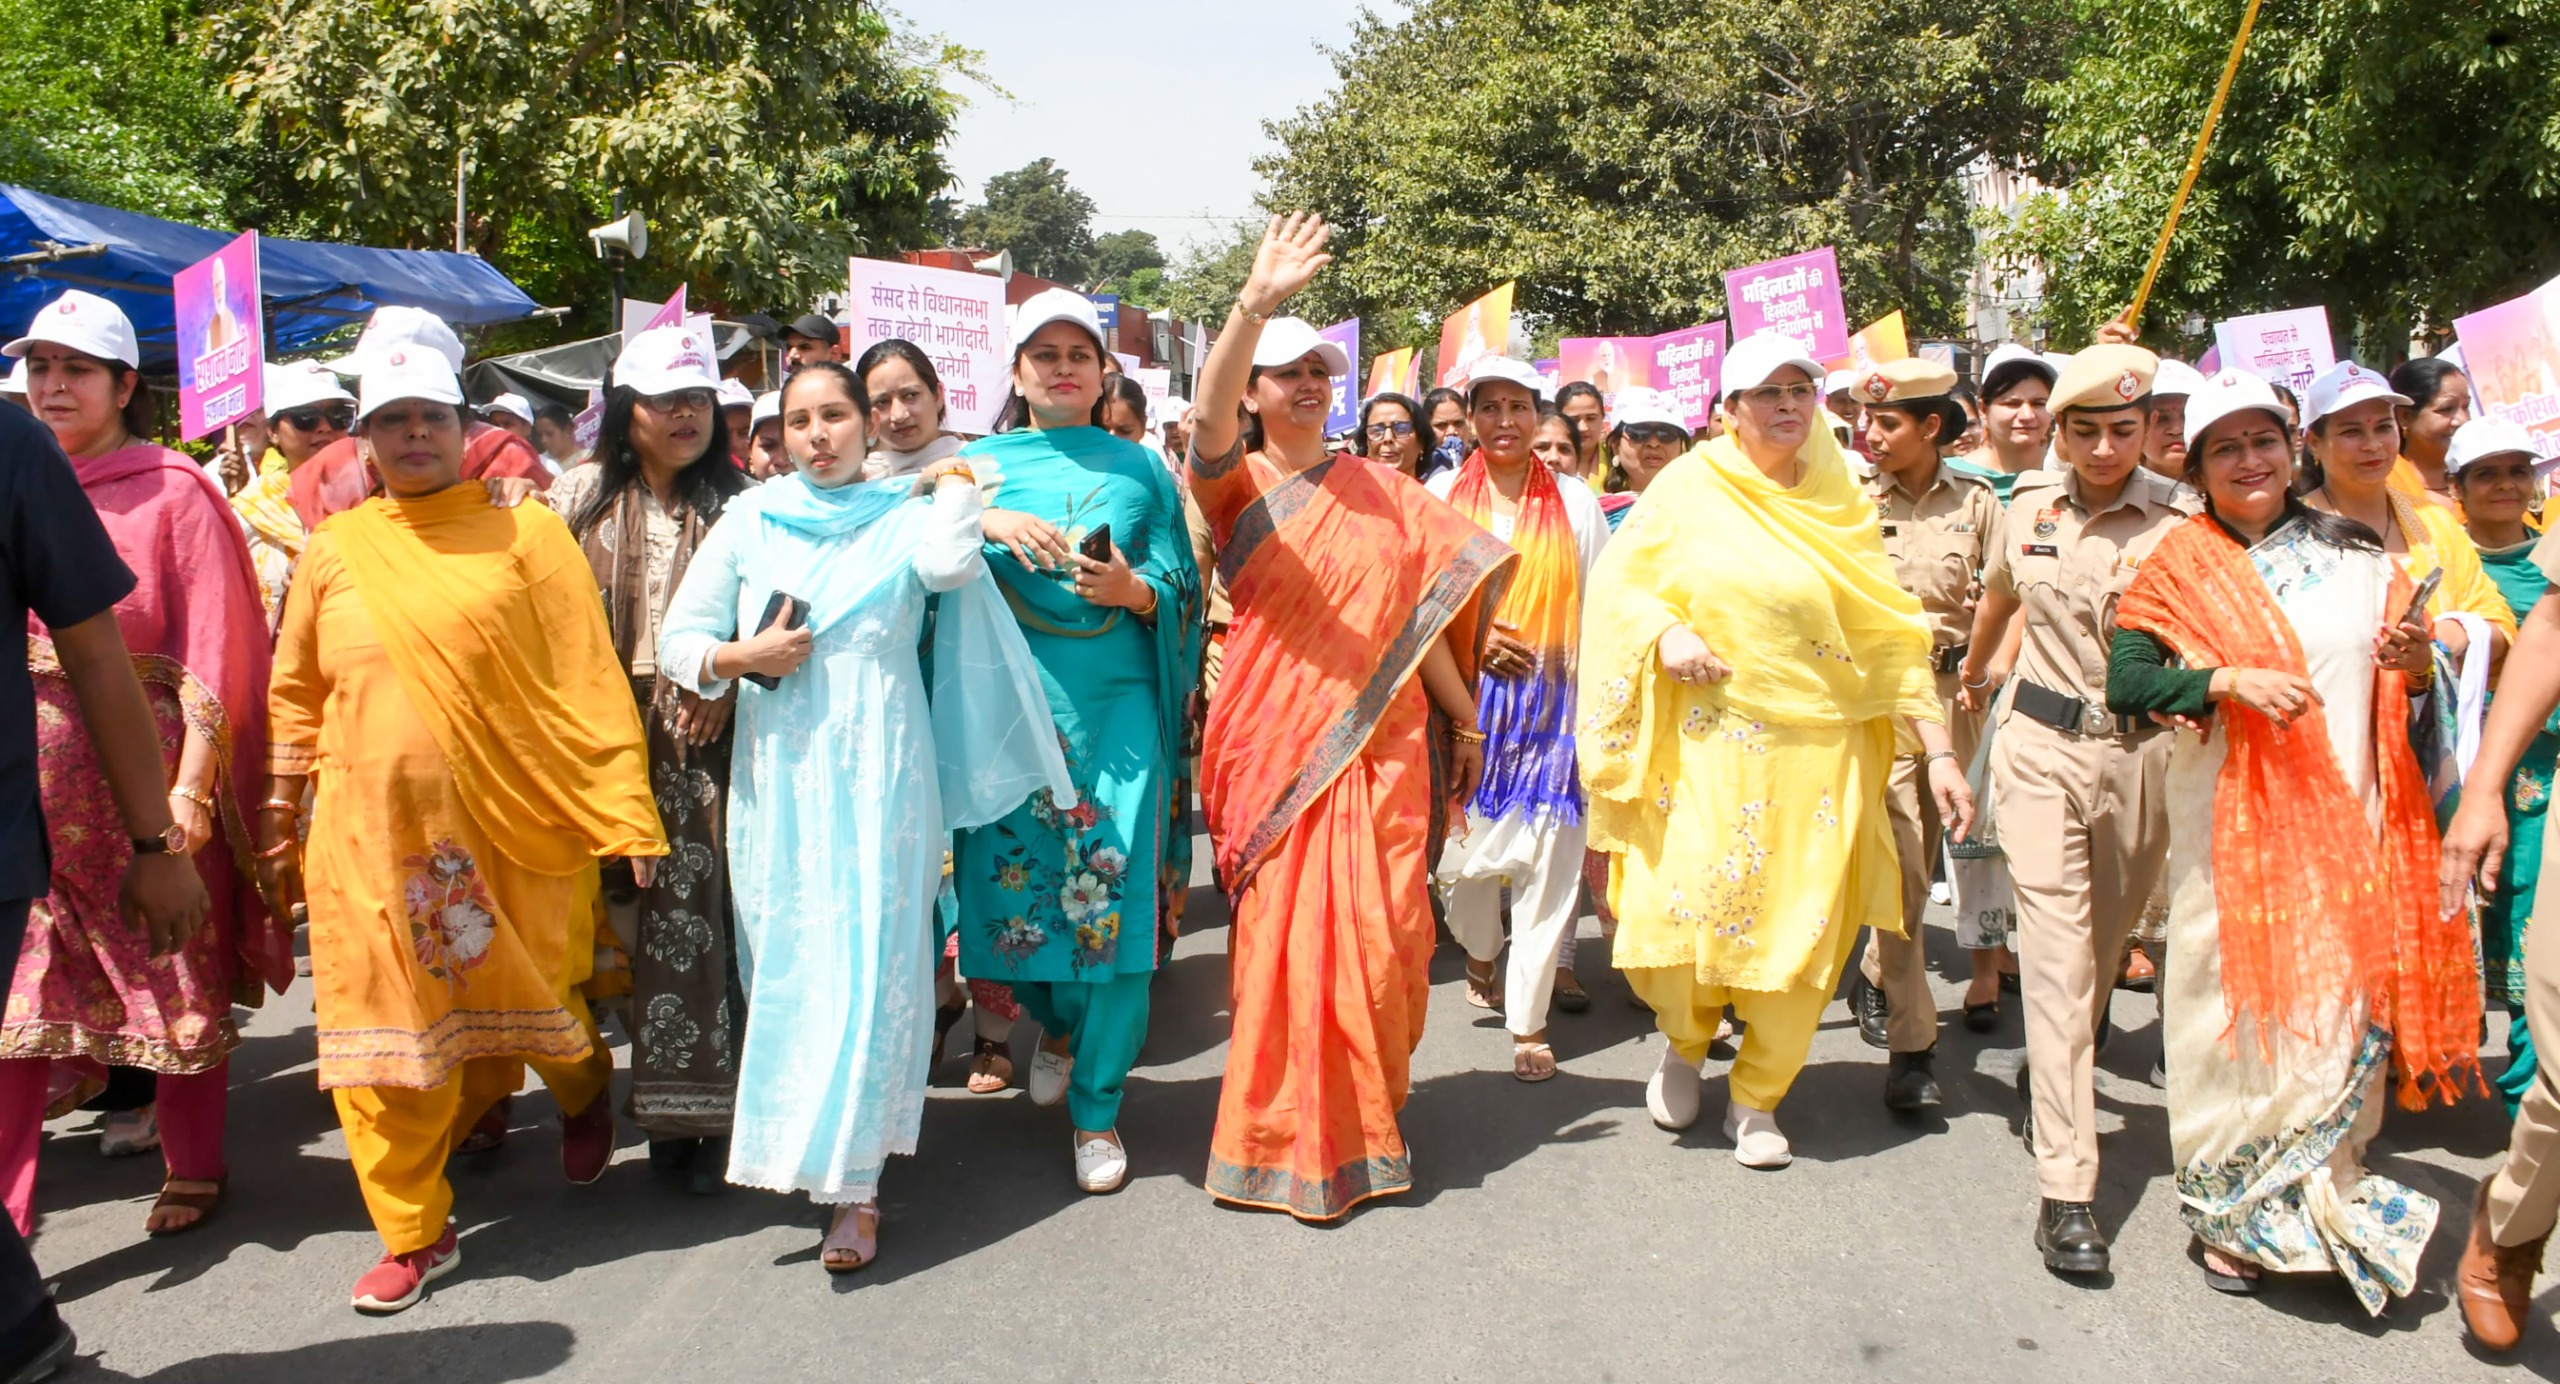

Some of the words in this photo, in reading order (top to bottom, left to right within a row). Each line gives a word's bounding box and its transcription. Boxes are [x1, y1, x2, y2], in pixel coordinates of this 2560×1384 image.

[1741, 266, 1807, 303] महिलाओं
[1807, 268, 1823, 288] की
[871, 282, 904, 311] संसद
[907, 284, 919, 311] से
[923, 286, 989, 320] विधानसभा
[868, 317, 892, 340] तक
[935, 321, 992, 354] भागीदारी,
[2260, 328, 2288, 346] पंचायत
[2289, 324, 2298, 342] से
[936, 351, 970, 379] बनेगी
[1657, 337, 1703, 368] महिलाओं
[1703, 340, 1715, 358] की
[2291, 364, 2315, 391] नारी
[949, 384, 977, 411] नारी
